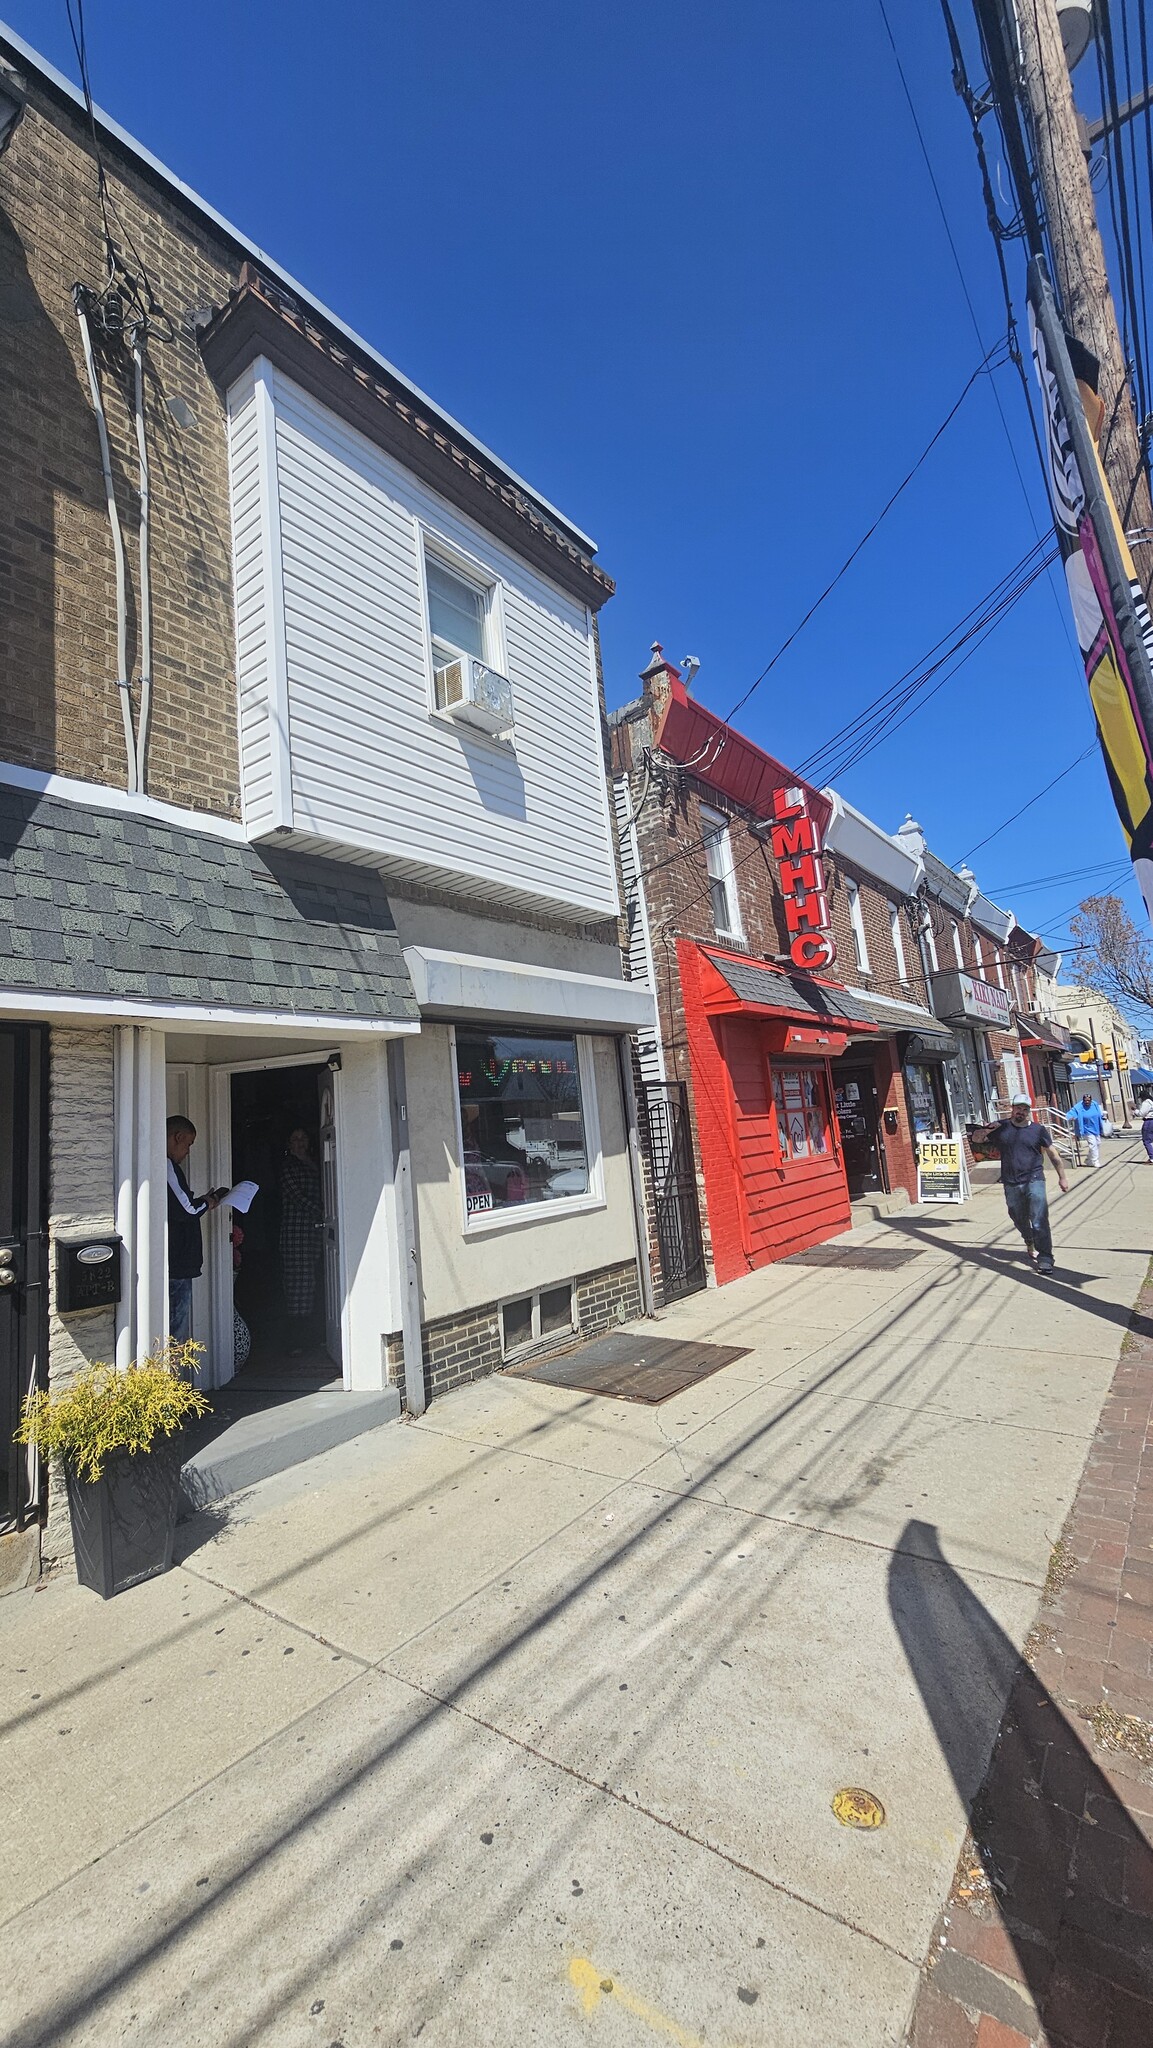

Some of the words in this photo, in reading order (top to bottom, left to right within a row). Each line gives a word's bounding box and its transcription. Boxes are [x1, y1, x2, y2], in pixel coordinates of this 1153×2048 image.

[771, 787, 828, 968] LMHHC
[972, 980, 992, 1006] KIKI
[922, 1143, 957, 1157] FREE
[933, 1157, 957, 1165] PRE-K
[466, 1194, 490, 1211] OPEN
